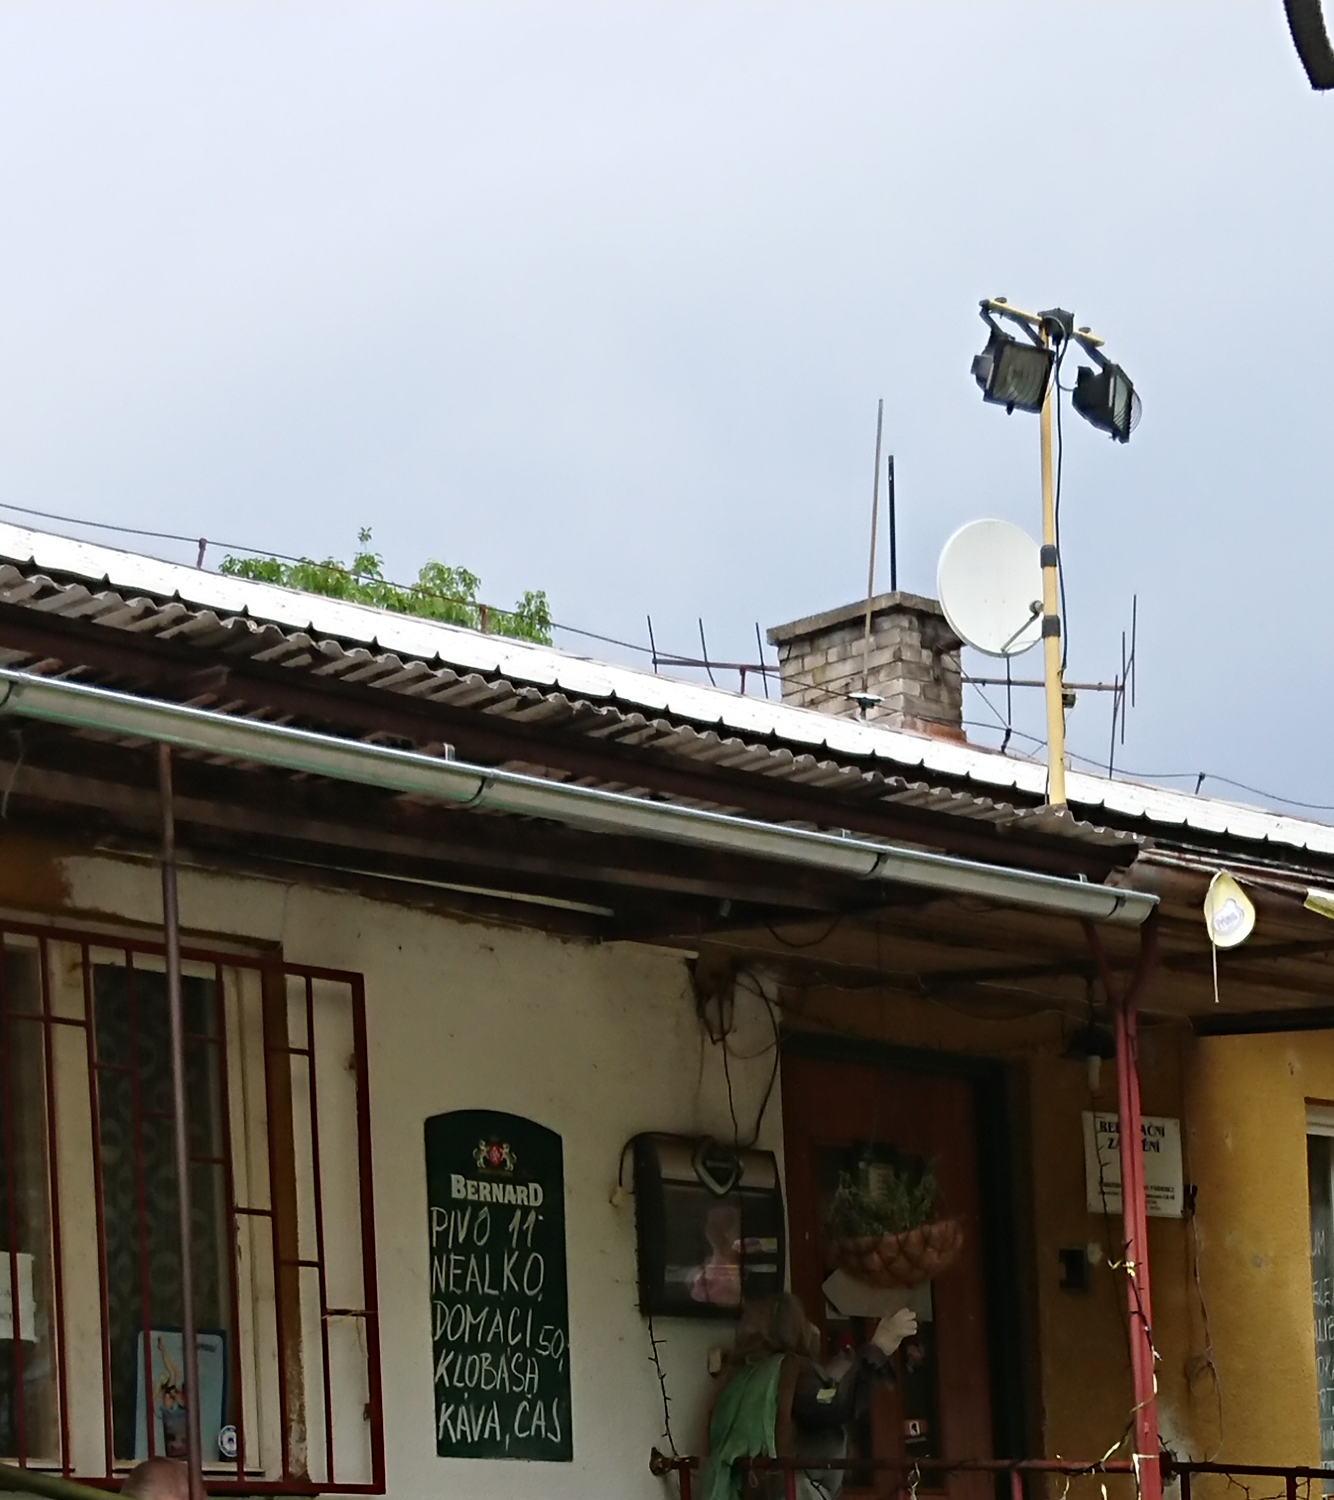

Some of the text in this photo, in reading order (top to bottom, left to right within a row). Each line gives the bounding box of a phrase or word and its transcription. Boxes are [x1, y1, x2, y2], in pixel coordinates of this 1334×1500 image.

[450, 1173, 544, 1207] BERNARD
[430, 1206, 491, 1249] PIVO
[432, 1250, 545, 1297] NEALKO
